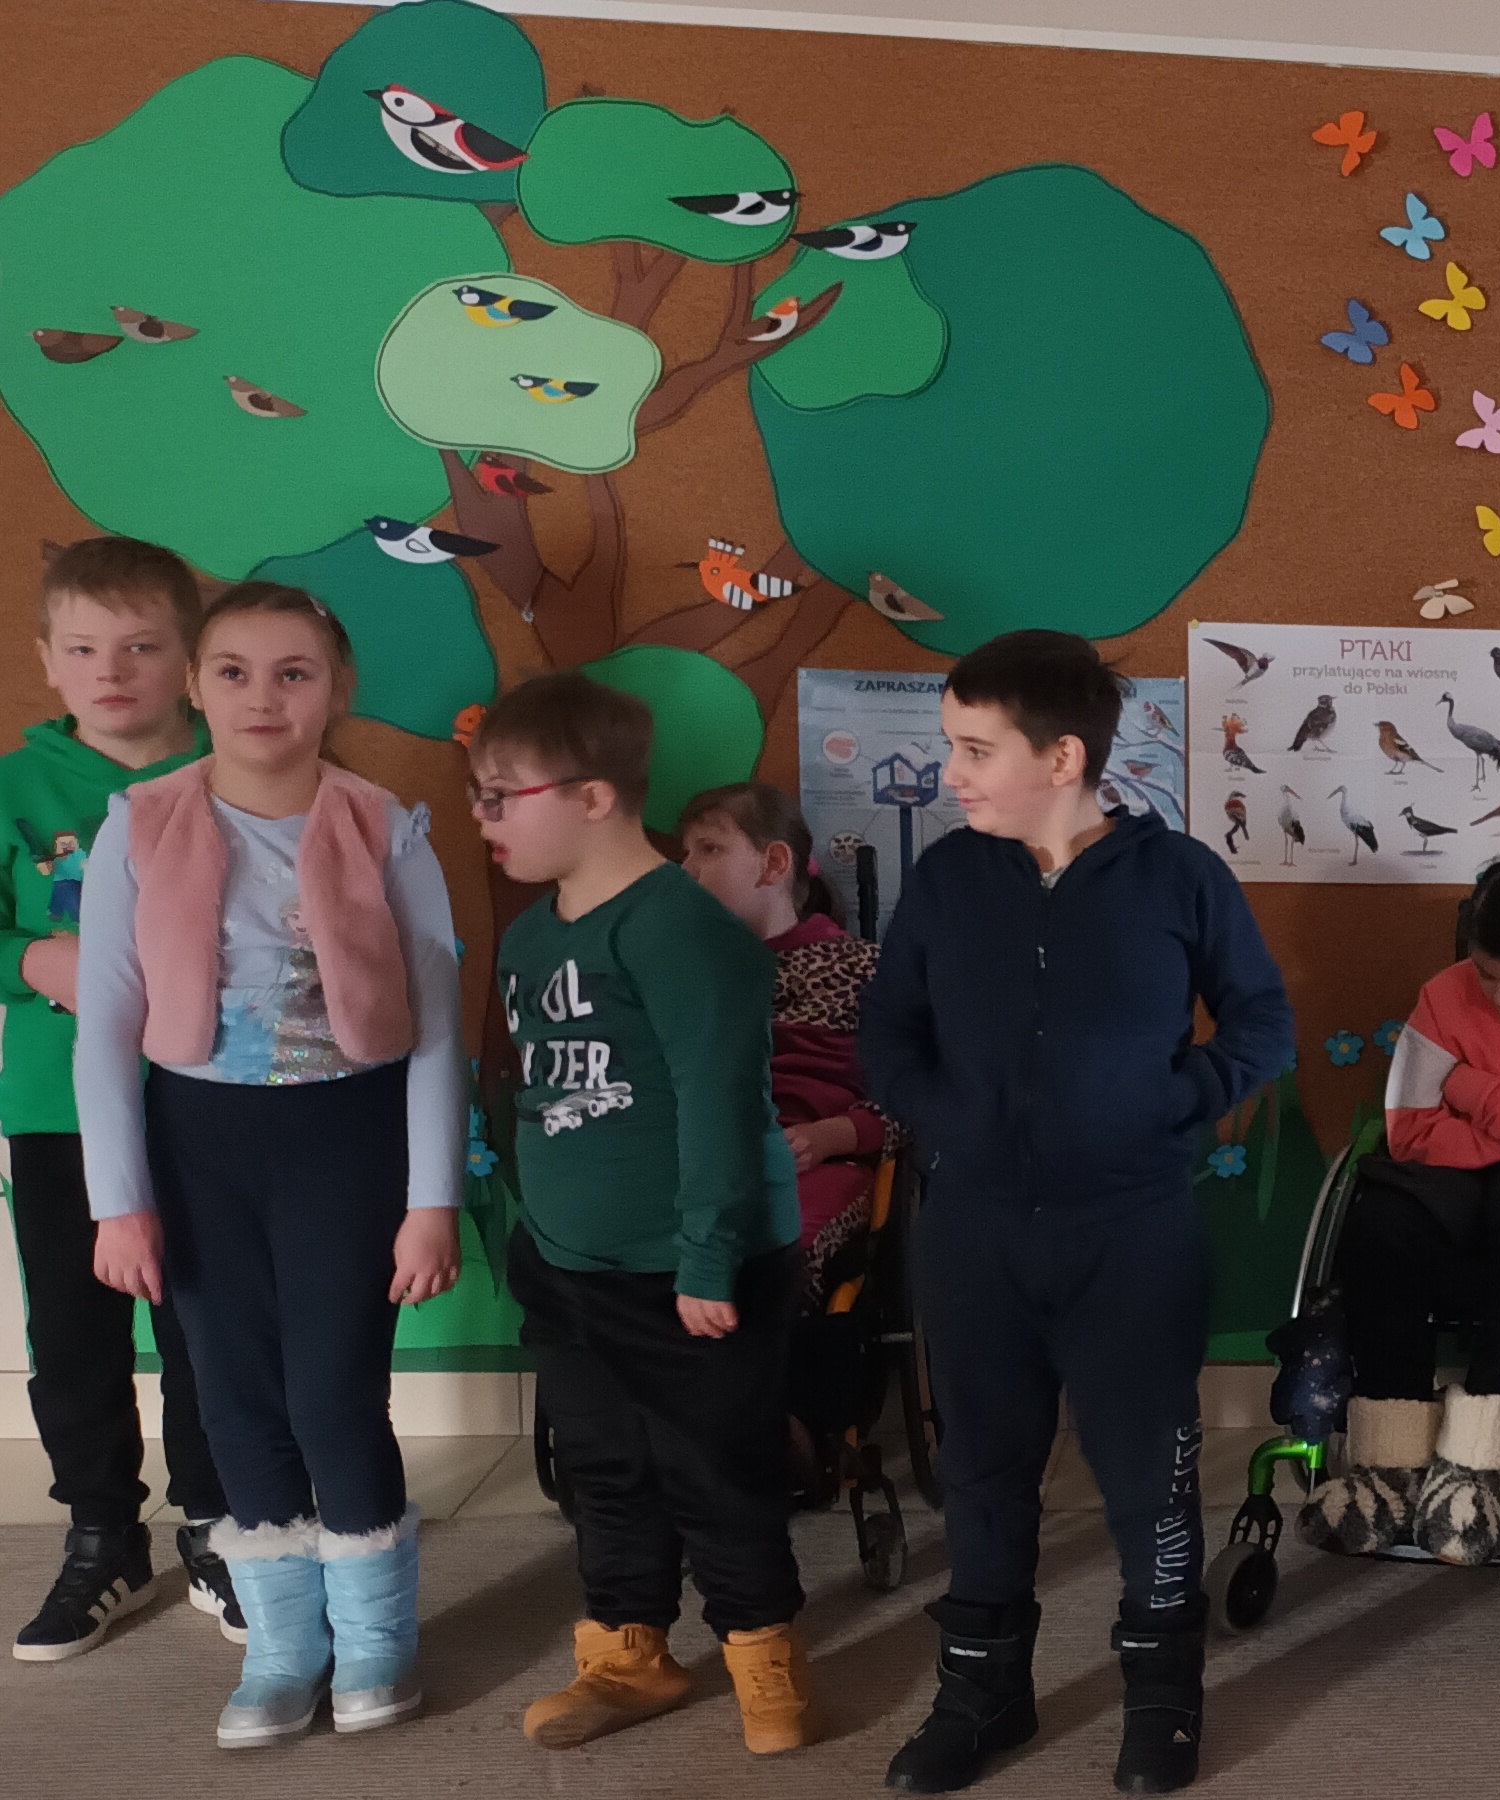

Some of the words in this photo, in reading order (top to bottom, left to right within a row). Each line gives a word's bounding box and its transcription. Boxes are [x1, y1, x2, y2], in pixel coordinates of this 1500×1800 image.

[1339, 639, 1412, 662] PTAKI
[1292, 664, 1381, 680] przylatujące
[1384, 667, 1403, 678] na
[1407, 667, 1458, 682] wiosnę
[1343, 682, 1362, 694] do
[1366, 682, 1408, 695] Polski
[505, 959, 594, 1033] COL
